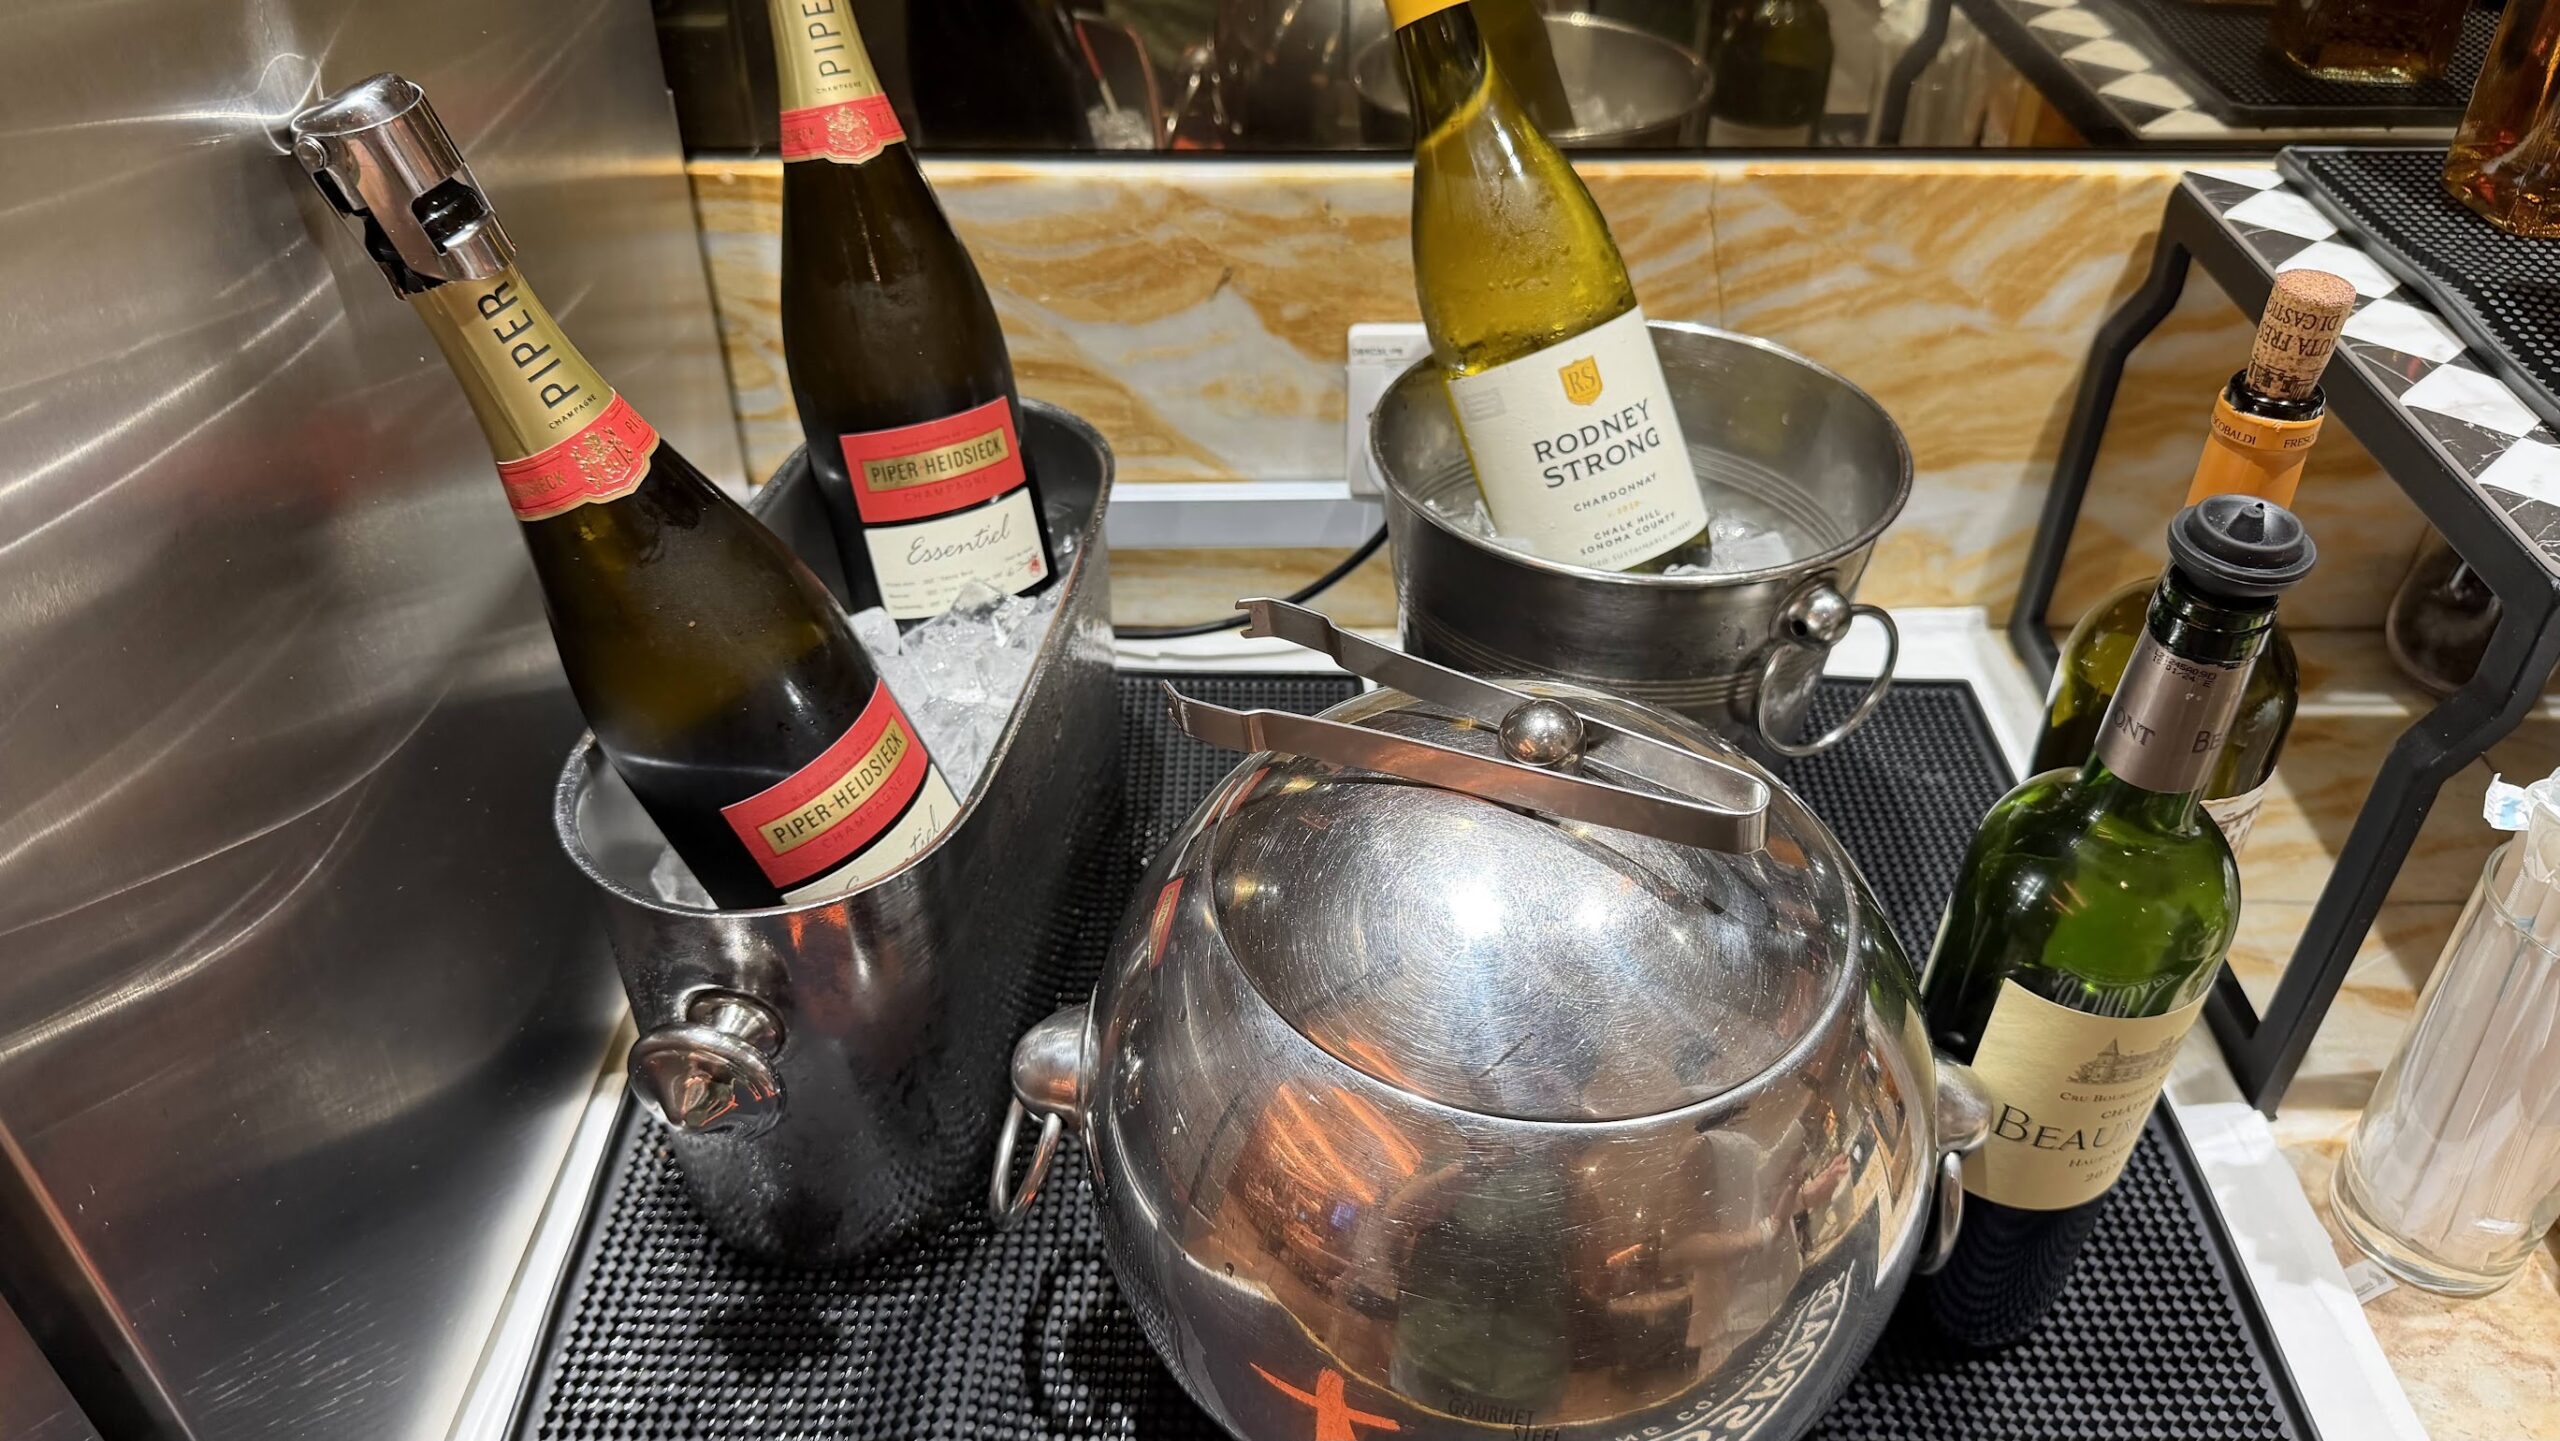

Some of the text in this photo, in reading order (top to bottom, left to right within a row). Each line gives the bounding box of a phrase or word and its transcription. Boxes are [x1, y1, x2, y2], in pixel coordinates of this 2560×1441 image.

[477, 281, 580, 409] PIPER
[2319, 314, 2341, 332] DI
[1567, 365, 1598, 395] RS
[549, 394, 598, 430] CHAMPAGNE
[1532, 397, 1651, 465] RODNEY
[870, 436, 1003, 484] PIPER-HEIDSIECK
[1542, 426, 1661, 489] STRONG
[903, 474, 990, 503] CHAMPAGNE
[1573, 472, 1657, 512] CHARDONNAY
[906, 513, 1011, 566] Essentiel
[1580, 511, 1676, 556] SONOMA COUNTY
[1593, 509, 1661, 541] CHALK HILL
[772, 728, 904, 845] PIPER-HEIDSIECK
[822, 776, 905, 849] CHAMPAGNE
[1448, 1396, 1537, 1427] GOURMET
